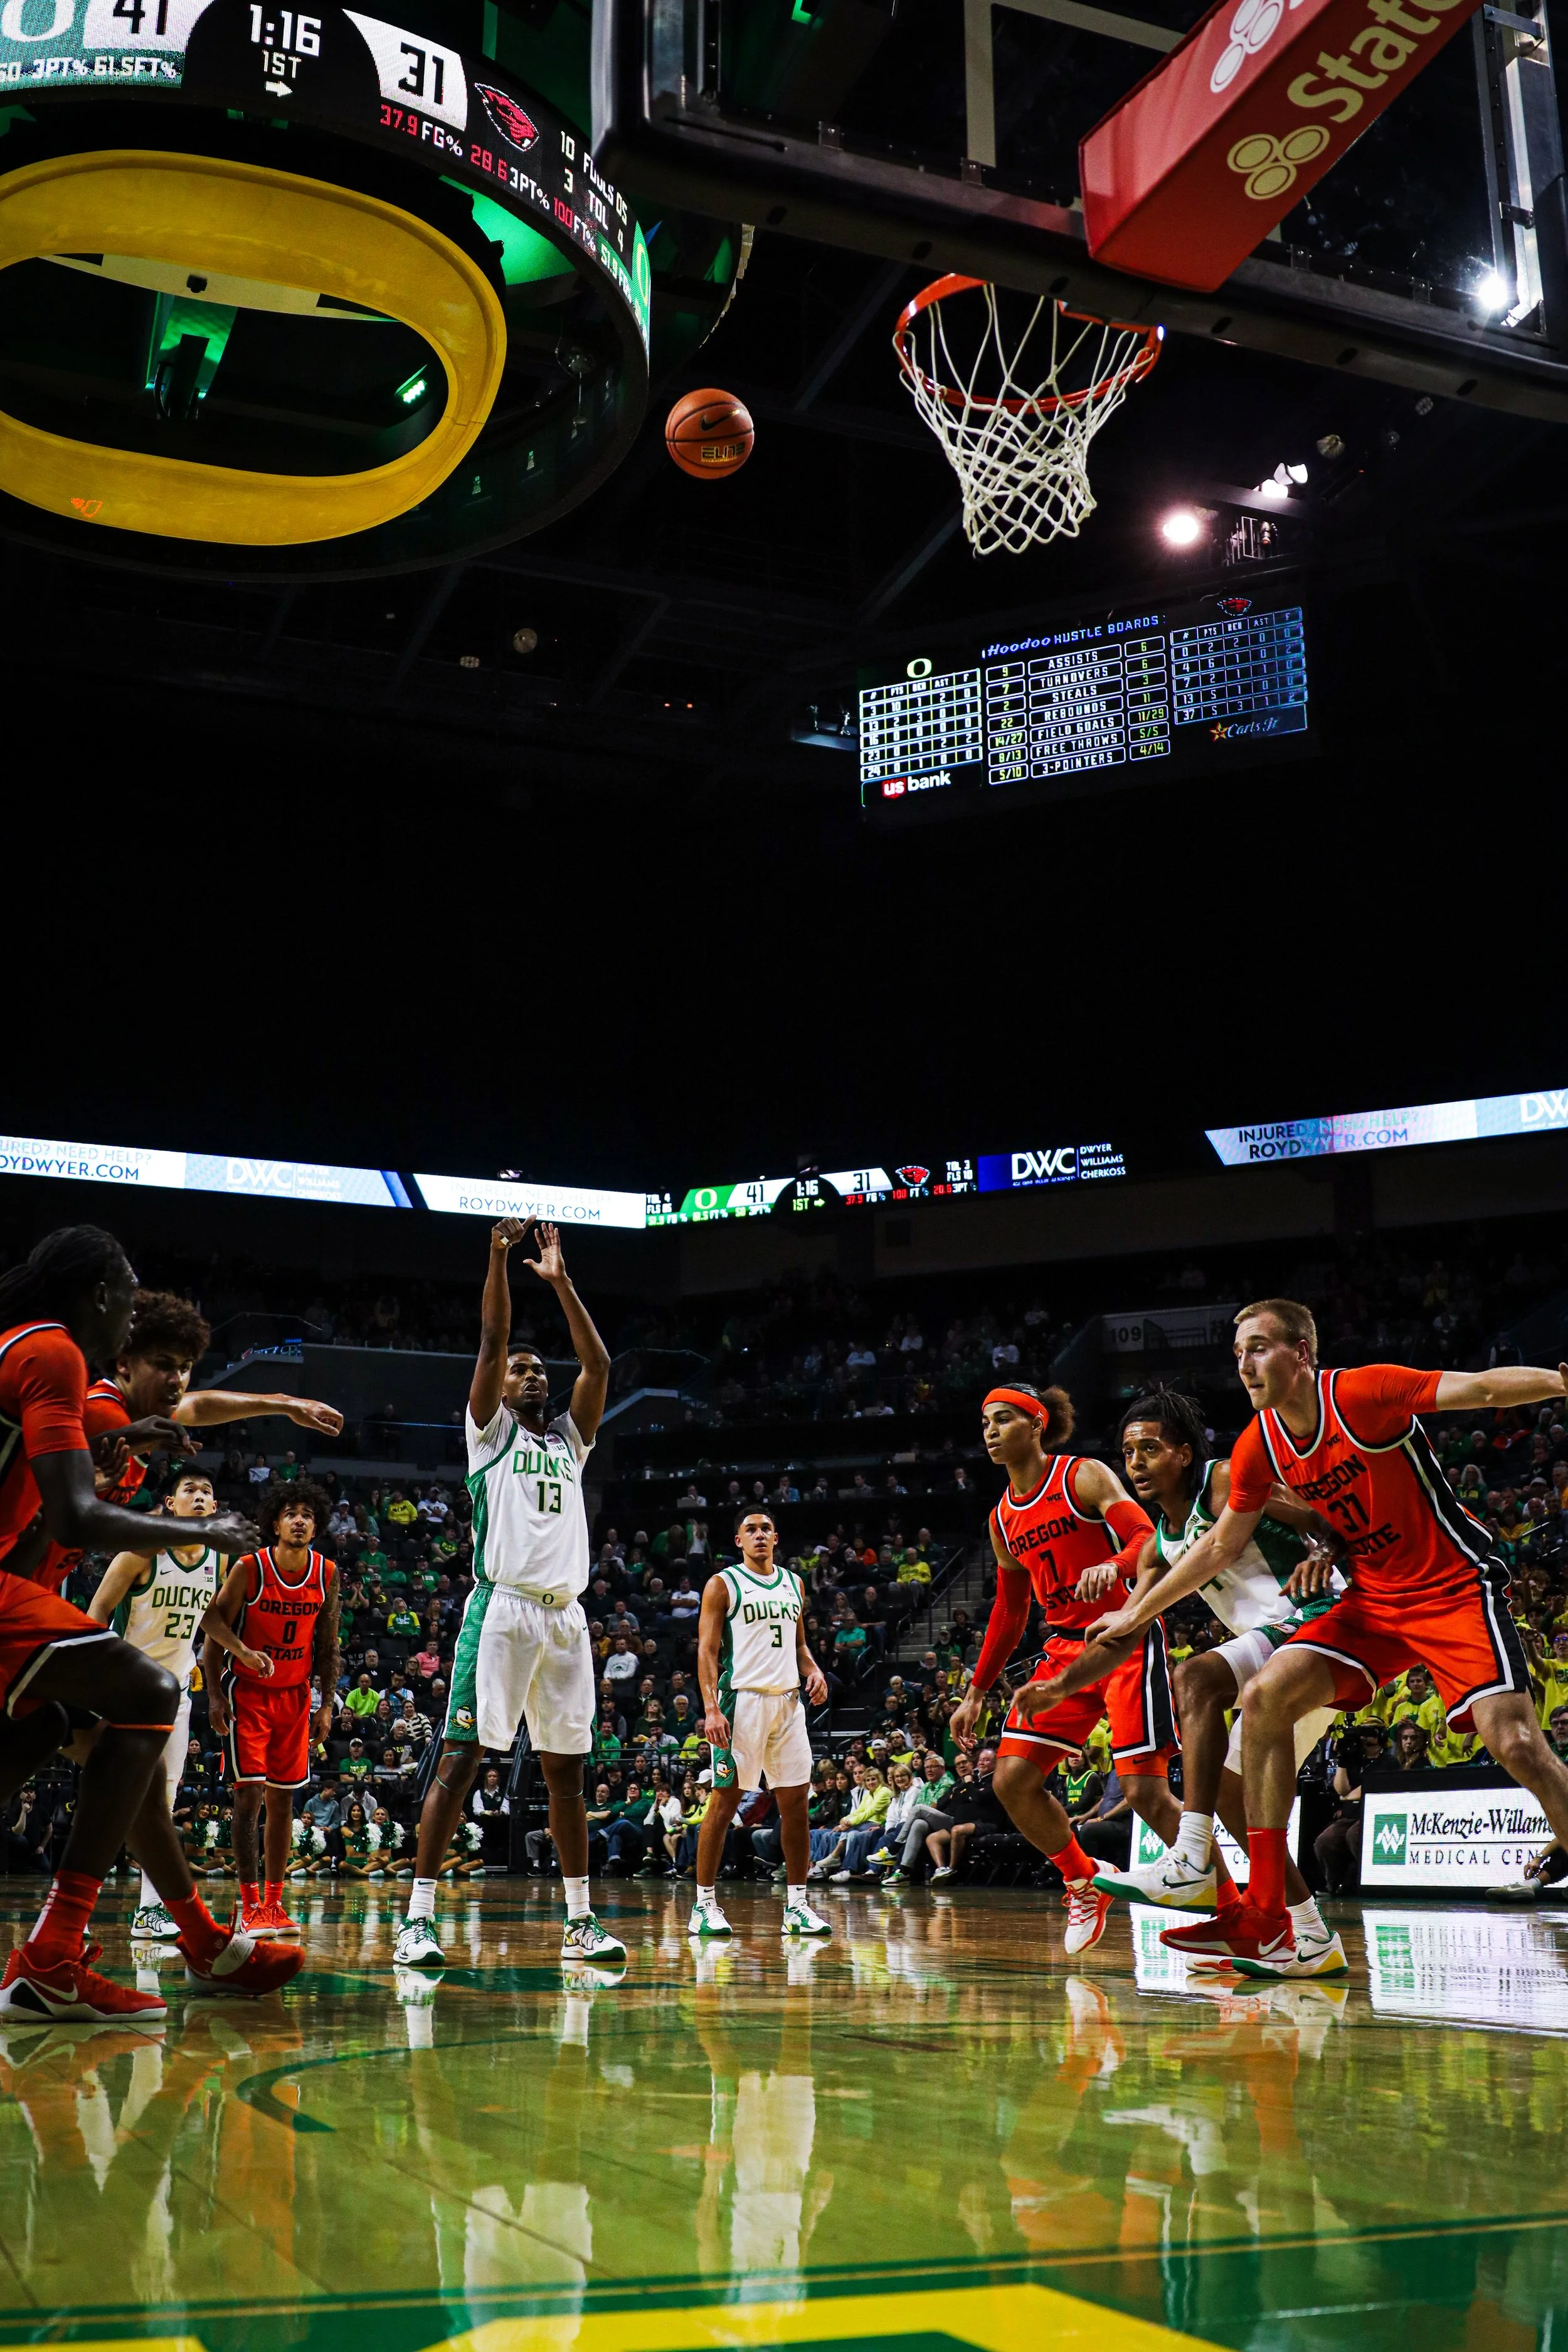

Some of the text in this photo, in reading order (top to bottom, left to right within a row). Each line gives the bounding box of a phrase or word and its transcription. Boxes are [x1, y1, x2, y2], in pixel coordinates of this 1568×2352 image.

[250, 3, 321, 57] 1:16
[262, 50, 302, 79] 1ST
[1288, 0, 1465, 123] Stat
[399, 41, 444, 105] 31
[560, 130, 575, 161] 10
[380, 104, 596, 252] 37.9 FG% 28.6 3PT% 100 FT%
[564, 167, 573, 193] 3
[588, 189, 609, 230] TOL
[701, 442, 745, 459] ELITE
[987, 616, 1158, 656] Hoodoo HUSTLE BOARDS
[1204, 618, 1268, 637] PTS AST
[1141, 642, 1147, 652] 6
[1182, 633, 1265, 657] 0 2 2 0
[907, 658, 931, 678] O
[1049, 652, 1098, 669] ASSISTS
[1142, 659, 1147, 669] 6
[1182, 649, 1266, 672] 4 6 0
[1002, 668, 1009, 676] 9
[1041, 667, 1108, 688] TURNOVERS
[1143, 675, 1148, 684] 3
[1184, 674, 1215, 687] 7 2
[935, 678, 948, 687] AST
[1004, 684, 1009, 694] 7
[871, 689, 970, 716] 3 10 2 0
[1052, 686, 1096, 702] STEALS
[1144, 693, 1150, 702] 11
[1184, 694, 1194, 704] 13
[1004, 701, 1009, 711] 2
[1045, 701, 1106, 721] REBOUNDS
[1138, 708, 1163, 722] 11/29
[1184, 709, 1195, 719] 37
[1237, 701, 1242, 711] 3
[869, 709, 945, 731] 13 2 3 0
[1001, 718, 1013, 728] 22
[1038, 718, 1114, 739] FIELD GOALS
[869, 718, 971, 746] 16 0 0 0 0
[995, 732, 1022, 748] 14/27
[868, 734, 972, 761] 23 0 2 2
[1036, 733, 1117, 757] FREE THROWS
[1140, 743, 1163, 755] 4/14
[868, 750, 972, 776] 24 0 0 0
[999, 750, 1021, 763] 8/13
[1042, 752, 1112, 774] 3-POINTERS
[884, 771, 951, 795] us bank
[1000, 766, 1022, 780] 5/10
[1080, 1143, 1112, 1155] DWYER
[1249, 1128, 1408, 1159] ROYDWYER.COM
[56, 1145, 98, 1160] NEED
[105, 1149, 152, 1165] HELP?
[964, 1160, 970, 1170] 3
[1012, 1147, 1076, 1180] DWC
[1081, 1154, 1124, 1167] WILLIAMS
[226, 1158, 292, 1189] DWC
[853, 1172, 870, 1192] 31
[1081, 1166, 1126, 1179] CHERKOSS
[747, 1184, 764, 1203] 41
[797, 1180, 818, 1197] 1:16
[893, 1189, 907, 1200] 100
[460, 1196, 600, 1221] ROYDWYER.COM
[793, 1198, 810, 1211] 1ST
[1111, 1327, 1142, 1343] 109
[513, 1451, 573, 1483] DUCKS
[1293, 1454, 1368, 1502] OREGON
[537, 1481, 561, 1514] 13
[1009, 1514, 1078, 1558] OREGON
[152, 1587, 213, 1611] DUCKS
[259, 1599, 320, 1616] OREGON
[743, 1601, 800, 1624] DUCKS
[164, 1613, 195, 1640] 23
[283, 1621, 298, 1645] 0
[770, 1624, 782, 1648] 3
[263, 1646, 305, 1661] STATE
[1410, 1848, 1539, 1865] MEDICAL CEN
